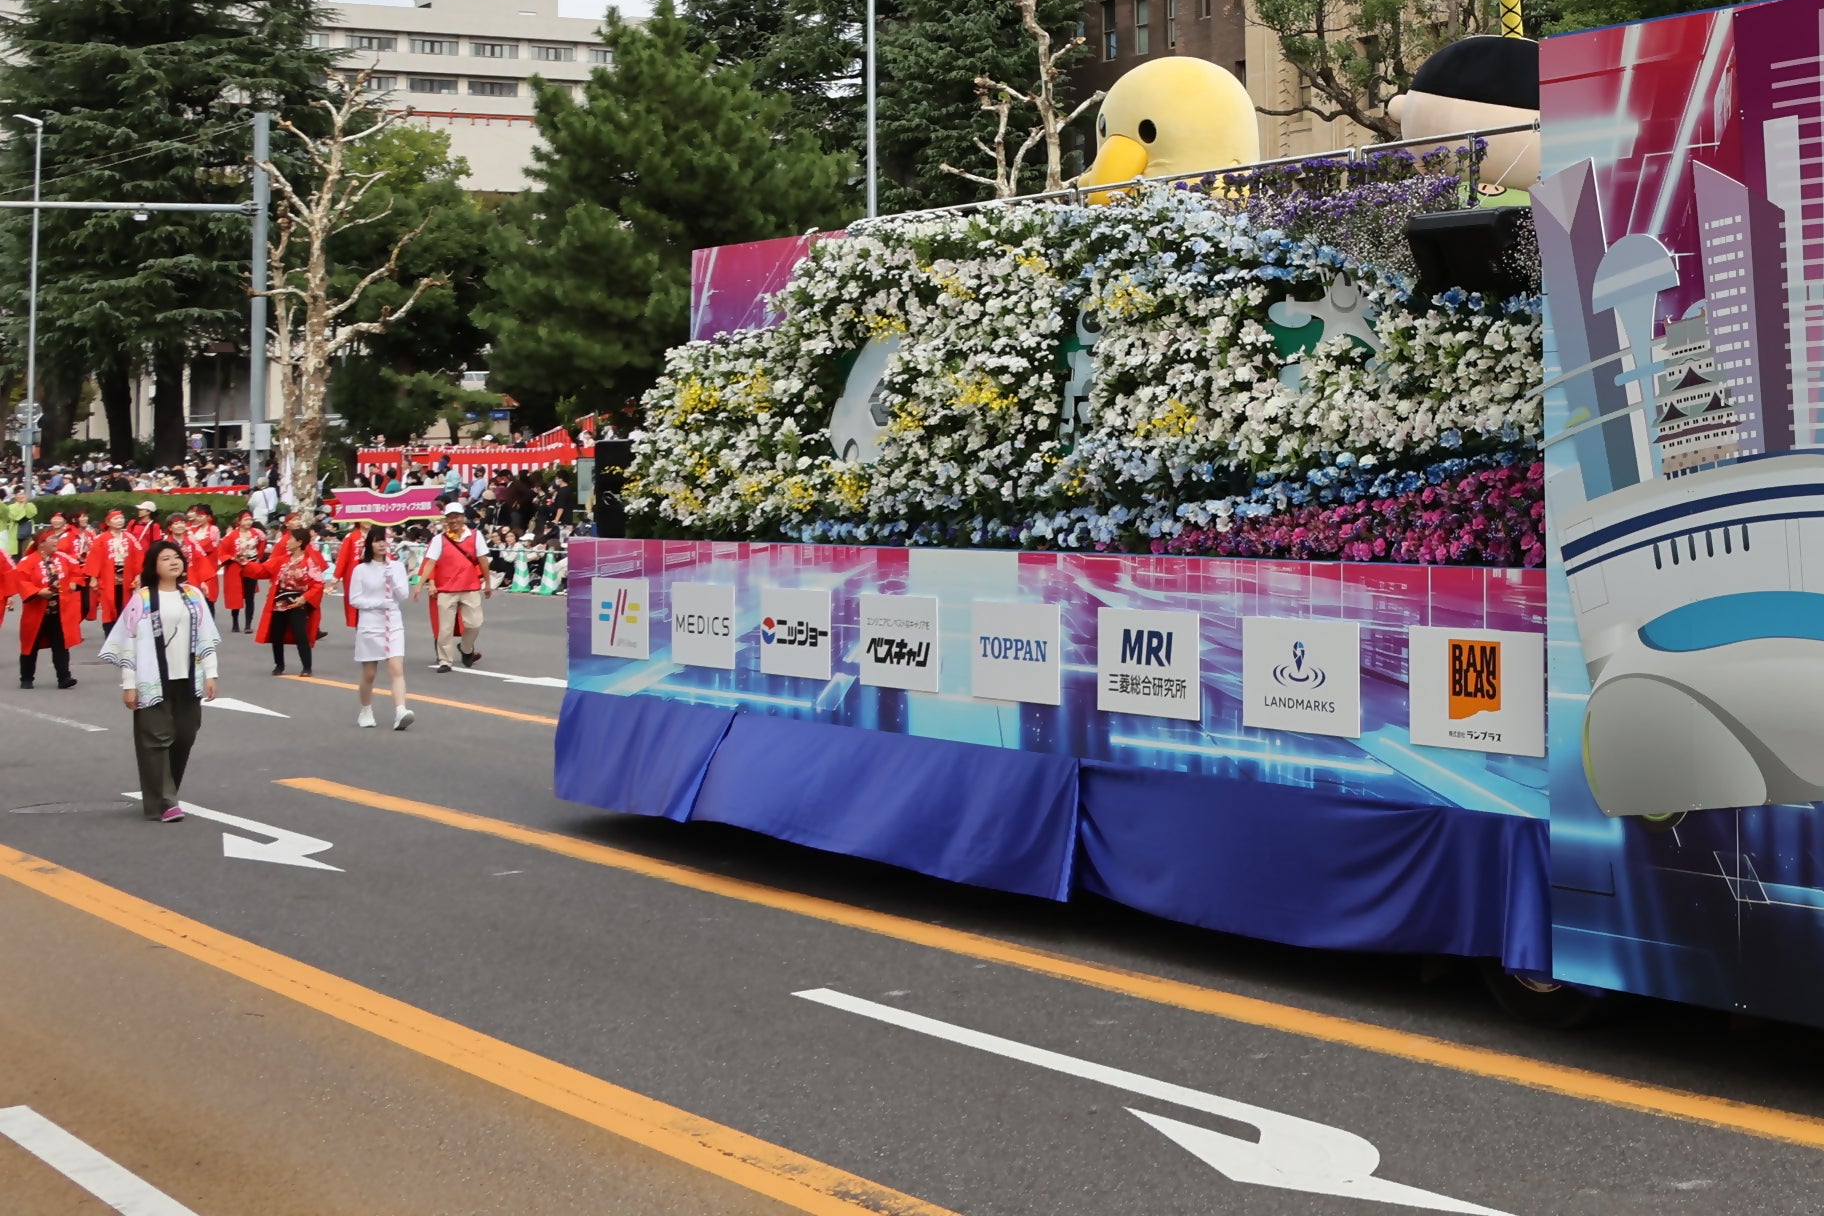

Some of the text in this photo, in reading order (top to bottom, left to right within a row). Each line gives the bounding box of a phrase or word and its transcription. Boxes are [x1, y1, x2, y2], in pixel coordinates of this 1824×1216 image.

[675, 613, 730, 637] MEDICS
[776, 619, 829, 647] ニッショー
[866, 637, 931, 668] ベスキャリ
[980, 635, 1048, 663] TOPPAN
[1121, 628, 1174, 668] MRI
[1451, 643, 1497, 680] BAM
[1108, 673, 1187, 700] 三菱総合研究所
[1451, 668, 1497, 700] BLAS
[1264, 695, 1336, 714] LANDMARKS
